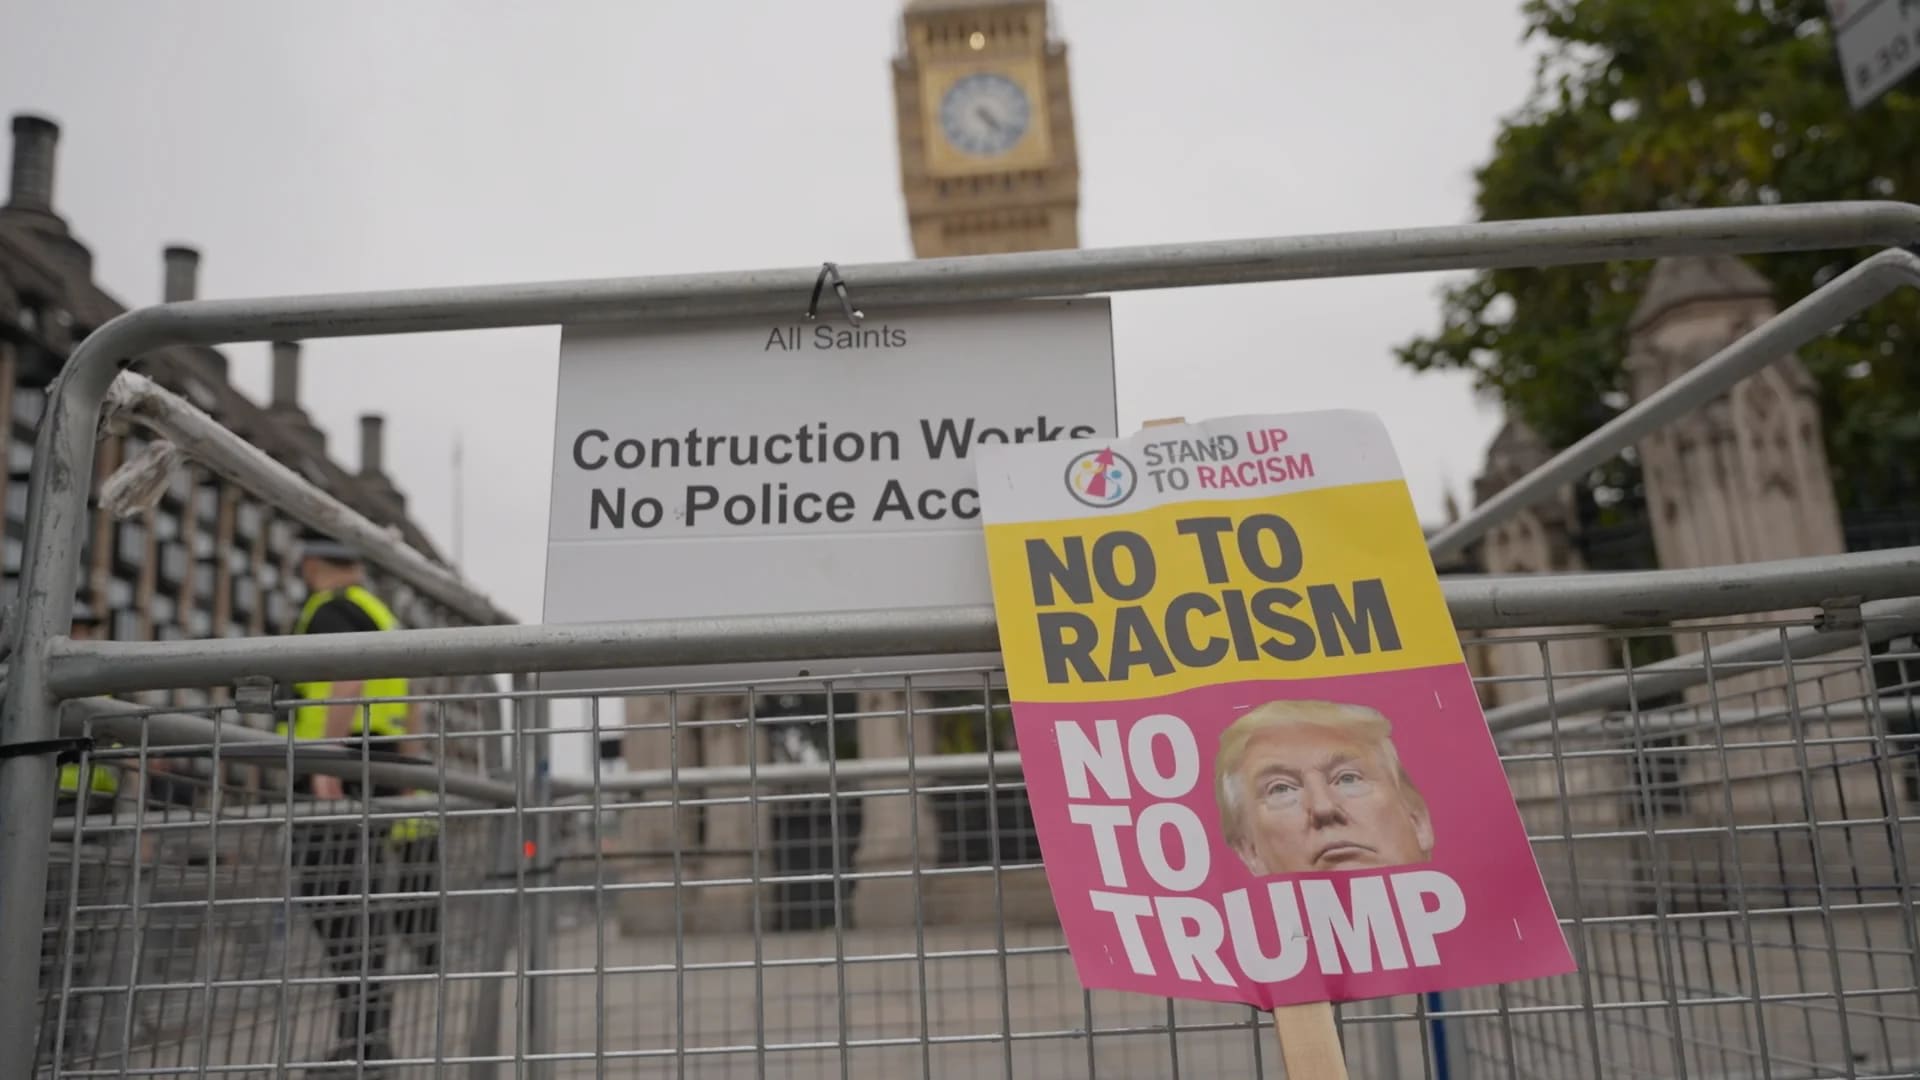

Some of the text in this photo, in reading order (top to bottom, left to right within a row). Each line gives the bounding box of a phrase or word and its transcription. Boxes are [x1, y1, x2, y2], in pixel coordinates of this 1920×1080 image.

[764, 323, 908, 352] All Saints
[572, 422, 900, 471] Contruction
[1142, 428, 1289, 468] STAND UP
[1148, 453, 1315, 494] TO RACISM
[589, 479, 982, 530] No Police Acc
[1025, 513, 1304, 607] NO TO
[1036, 578, 1403, 684] RACISM
[1054, 714, 1200, 800] NO
[1067, 802, 1212, 892] TO
[1088, 870, 1467, 988] TRUMP
